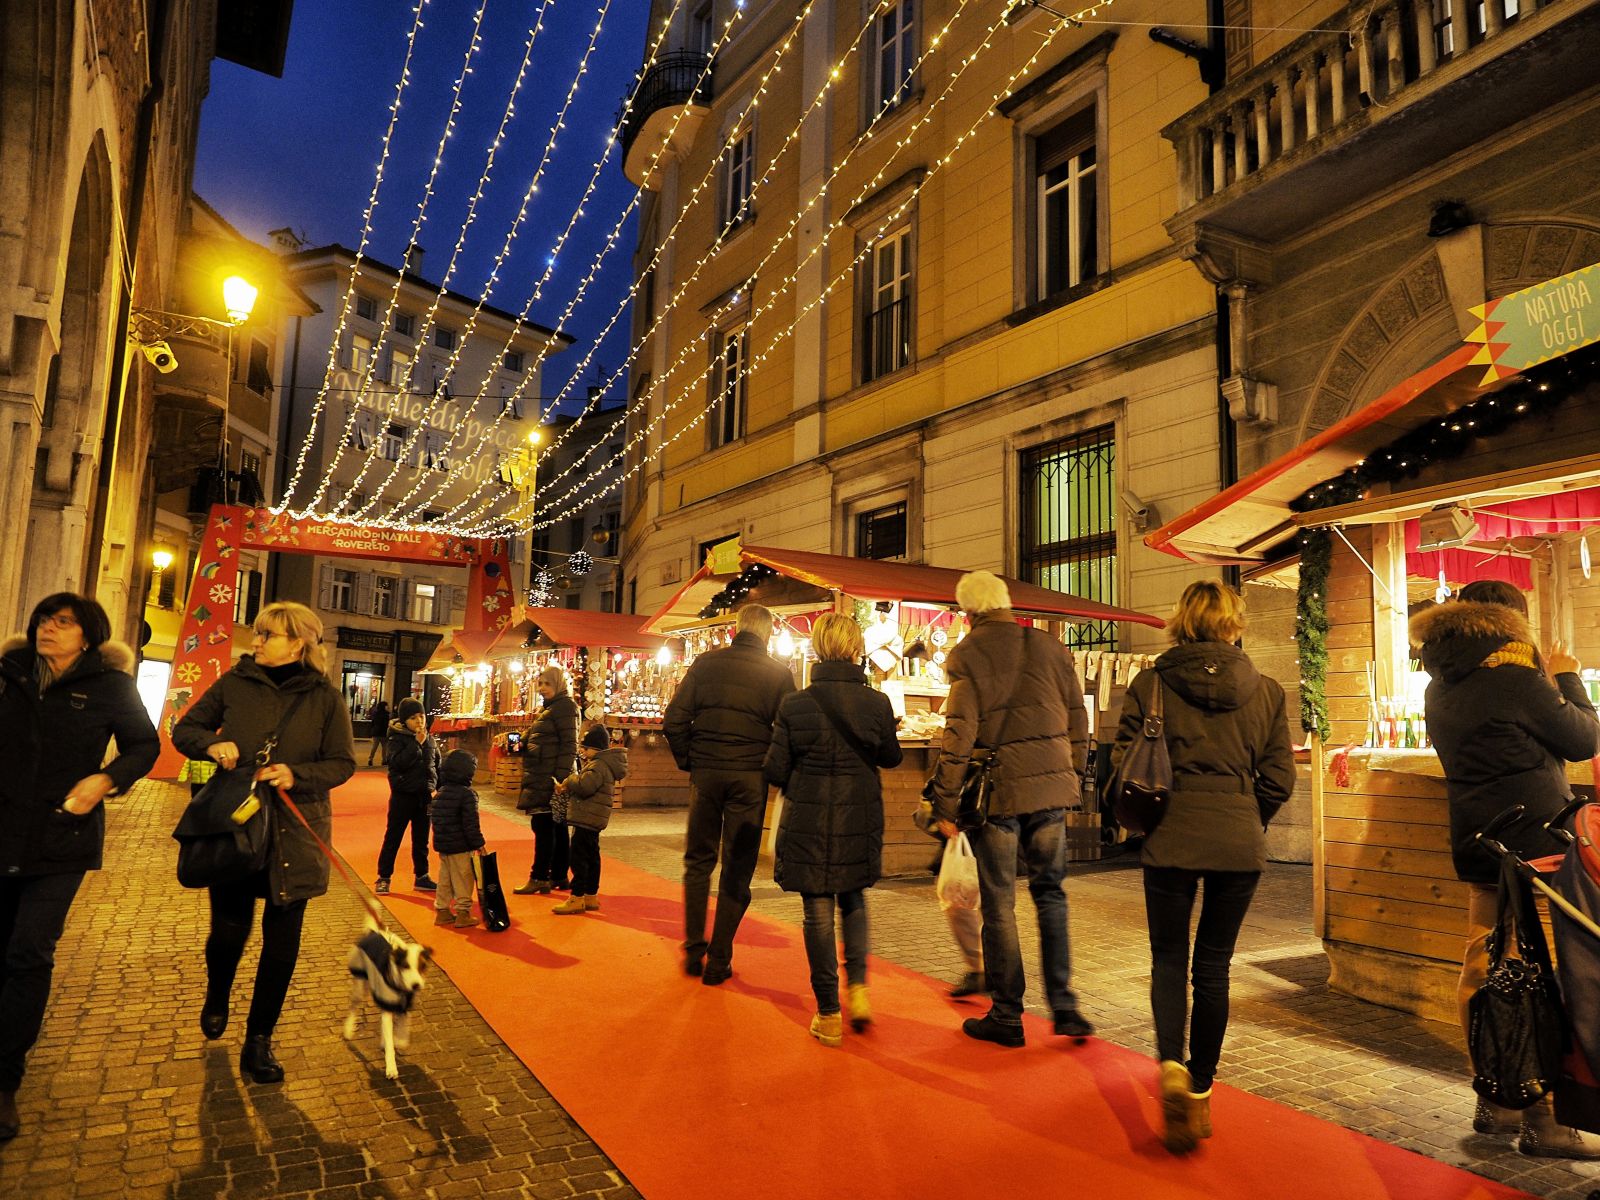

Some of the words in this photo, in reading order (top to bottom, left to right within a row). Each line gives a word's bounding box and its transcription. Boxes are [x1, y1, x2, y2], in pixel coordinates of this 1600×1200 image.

[1525, 280, 1592, 326] NATURA
[1542, 311, 1585, 349] OGGI
[334, 372, 423, 421] Natale
[431, 398, 461, 433] di
[456, 418, 518, 450] pace
[381, 531, 422, 544] NATALE
